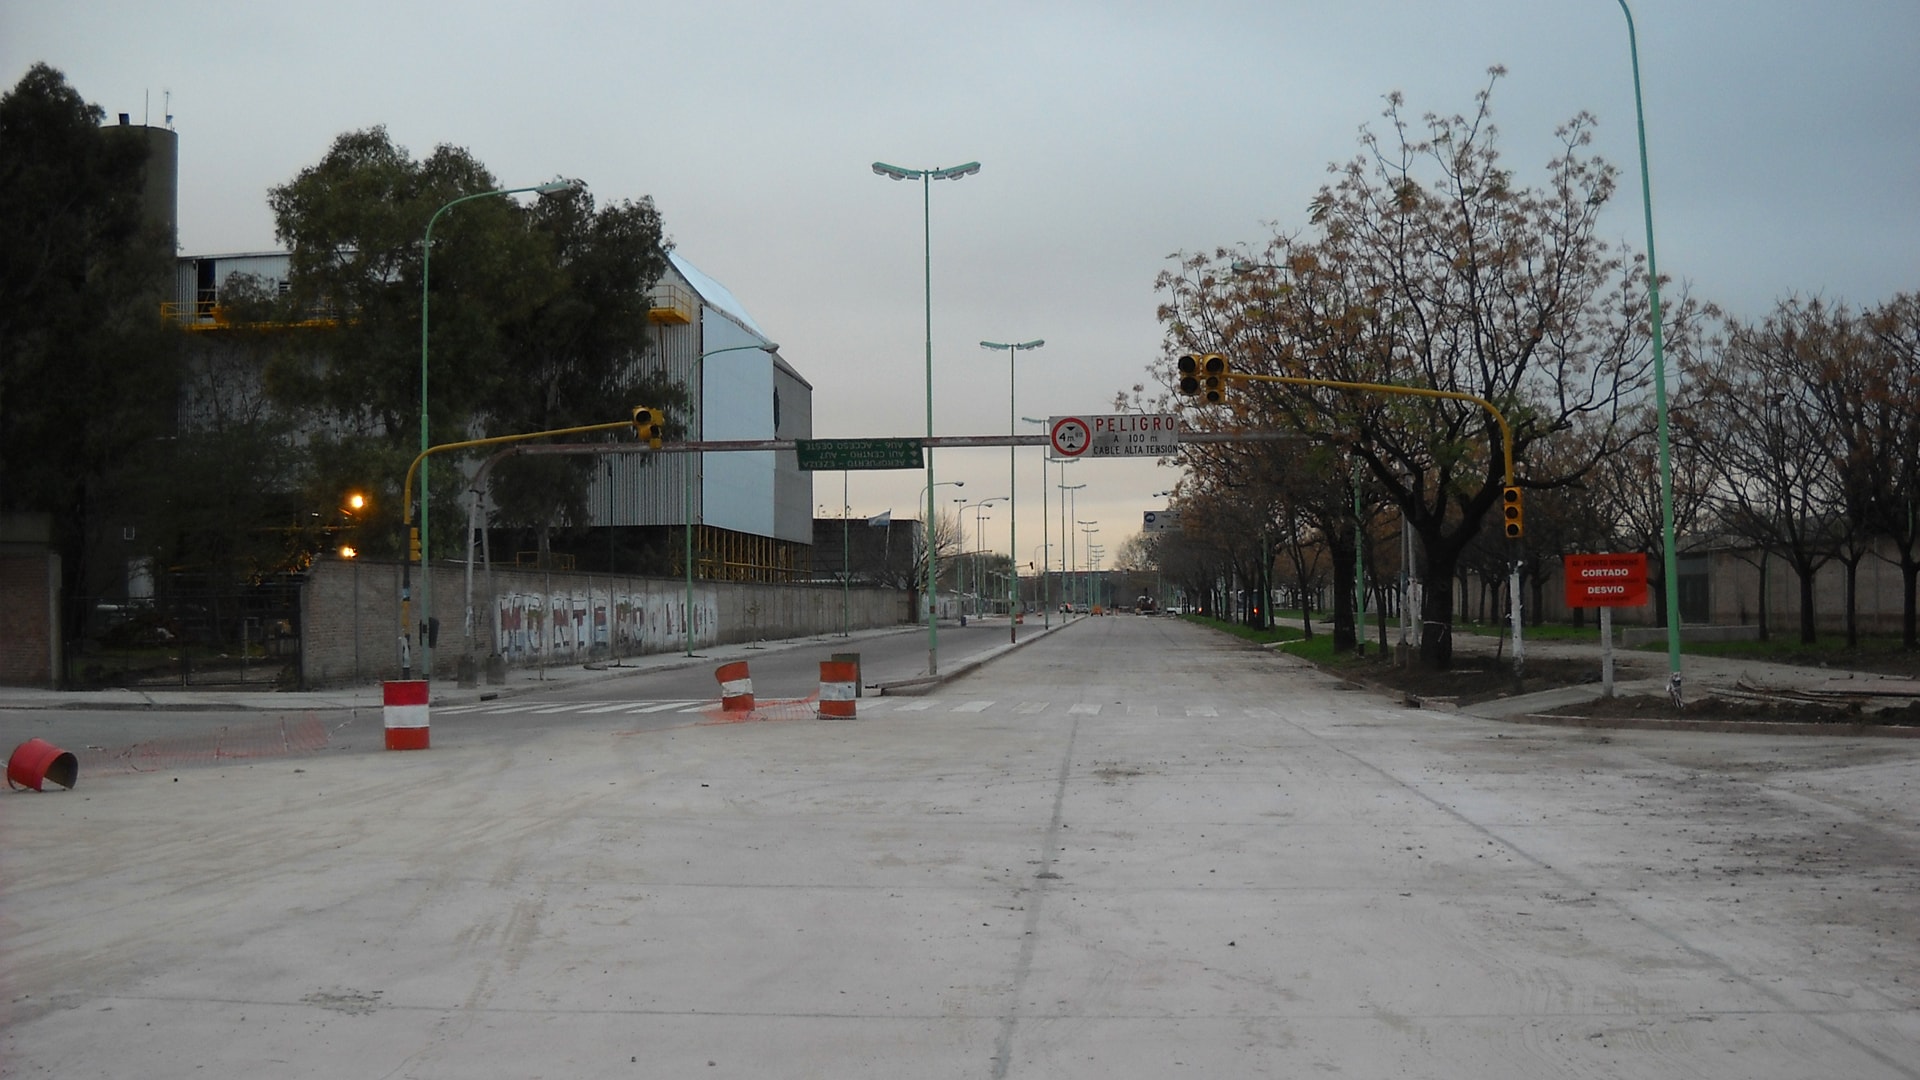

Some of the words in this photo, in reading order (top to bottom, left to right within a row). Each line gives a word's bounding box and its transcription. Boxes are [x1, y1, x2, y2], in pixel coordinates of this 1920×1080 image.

[1096, 416, 1174, 432] PELIGRO
[1113, 434, 1119, 443] A
[1128, 434, 1145, 443] 100
[805, 442, 833, 450] OESTE
[836, 441, 873, 449] ACCESO
[1093, 446, 1120, 455] CABLE
[1124, 445, 1143, 454] ALTA
[1146, 444, 1178, 454] TENSION
[849, 450, 885, 458] CENTRO
[848, 458, 906, 467] AEROPUERTO
[1581, 568, 1629, 577] CORTADO
[1587, 586, 1624, 594] DESVIO
